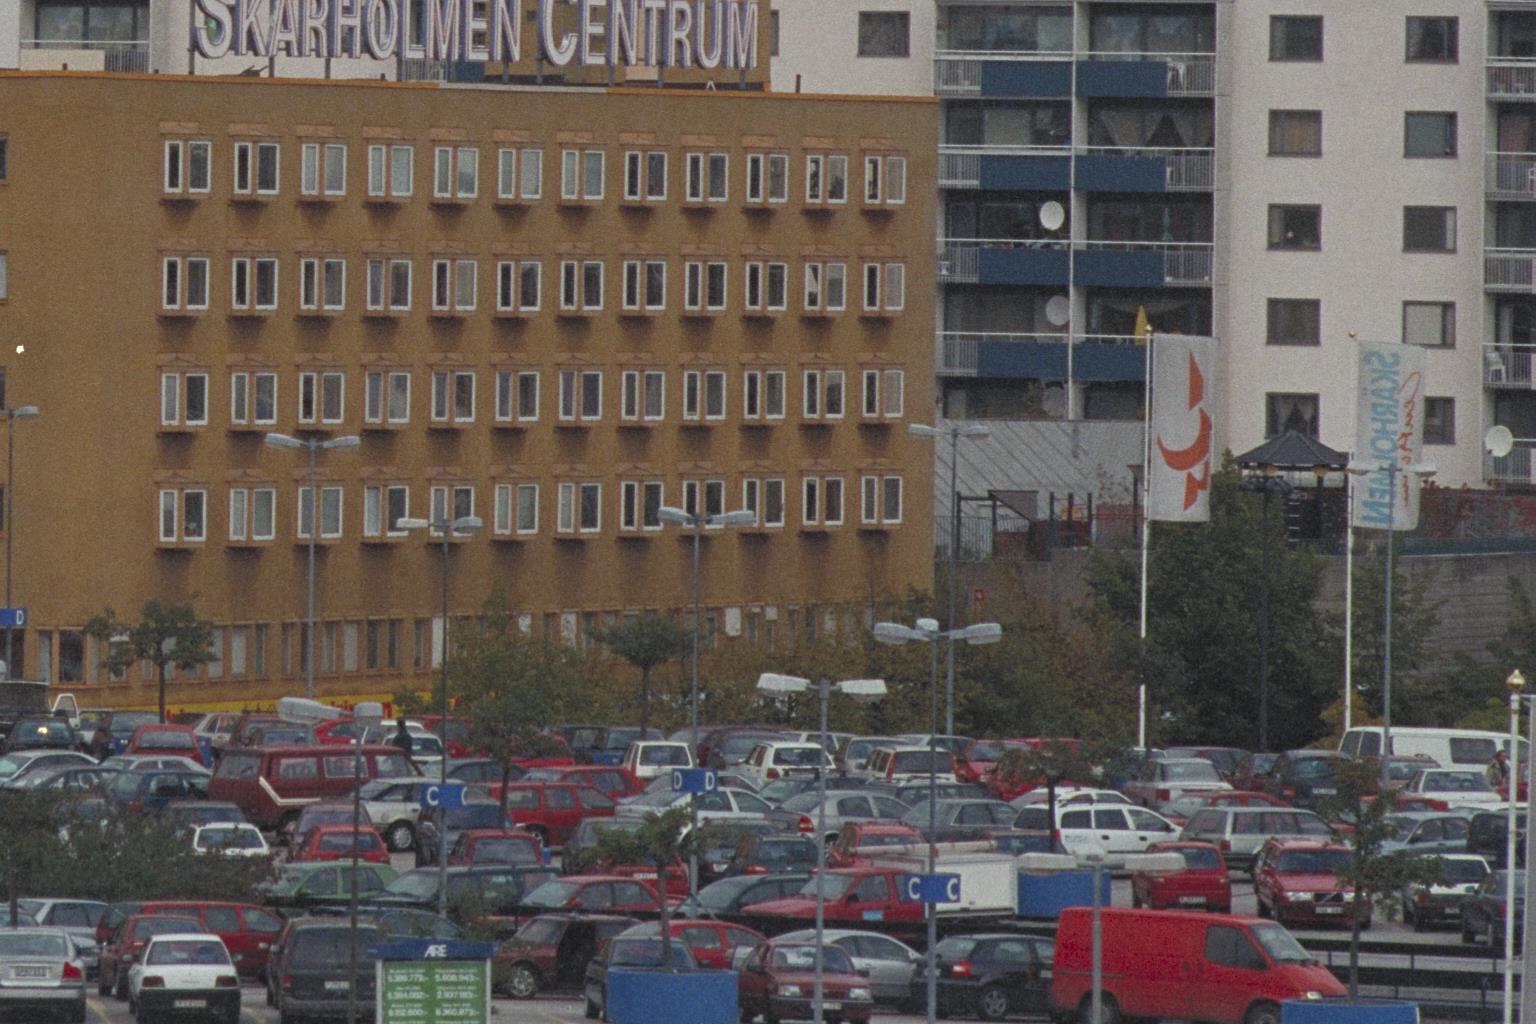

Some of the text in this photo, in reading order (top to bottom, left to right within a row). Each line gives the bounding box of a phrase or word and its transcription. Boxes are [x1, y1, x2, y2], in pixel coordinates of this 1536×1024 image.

[427, 786, 439, 805] C
[909, 877, 958, 900] C C
